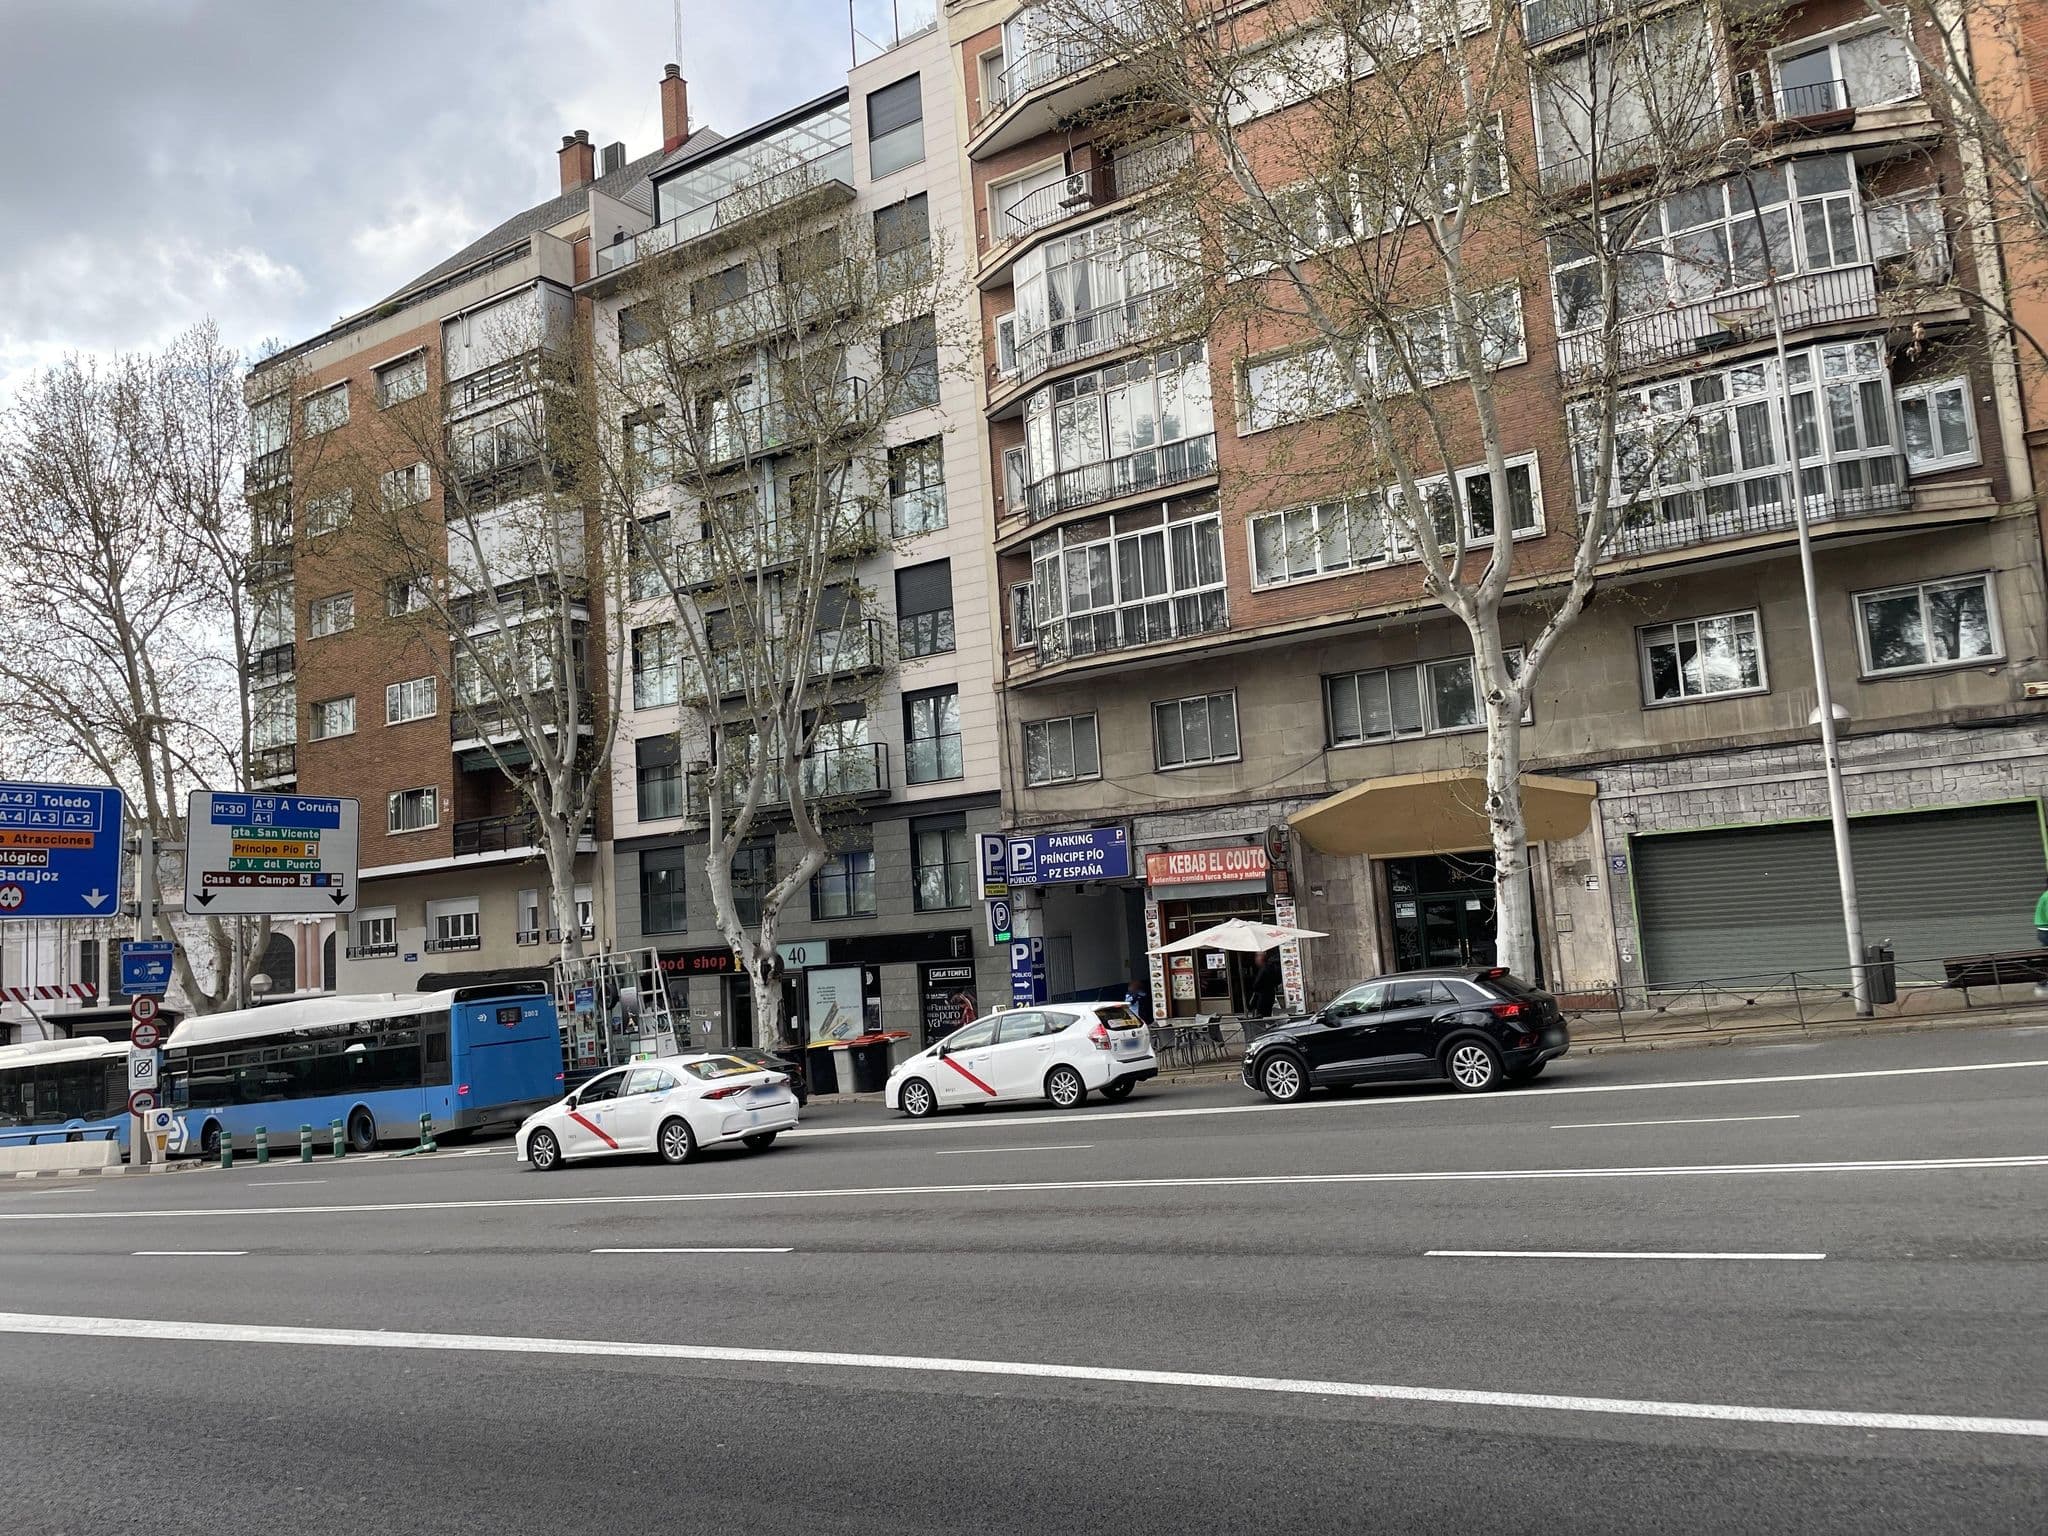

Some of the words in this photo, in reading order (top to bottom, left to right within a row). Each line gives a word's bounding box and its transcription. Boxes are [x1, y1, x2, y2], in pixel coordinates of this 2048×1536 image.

[0, 793, 33, 804] A-42
[42, 795, 91, 808] Toledo
[255, 798, 274, 808] A-6
[281, 800, 290, 810] A
[297, 801, 339, 813] Coruña
[215, 805, 244, 814] M-30
[0, 811, 23, 821] A-4
[32, 813, 57, 823] A-3
[66, 814, 90, 824] A-2
[255, 814, 270, 823] A-1
[13, 834, 91, 845] Atracciones
[232, 828, 255, 838] gta.
[257, 828, 278, 838] San
[281, 829, 319, 839] Vicente
[1049, 834, 1093, 848] PARKING
[1115, 829, 1123, 840] P
[984, 837, 1004, 876] P
[1011, 843, 1032, 872] P
[1040, 851, 1085, 865] PRÍNCIPE
[1086, 848, 1104, 861] PÍO
[1169, 853, 1206, 874] KEBAB
[1210, 852, 1224, 872] EL
[1226, 849, 1266, 871] COUTO
[247, 859, 257, 868] V.
[264, 860, 280, 869] del
[287, 860, 320, 869] Puerto
[1049, 868, 1062, 879] PZ
[1063, 863, 1103, 878] ESPAÑA
[0, 870, 59, 884] Badajoz
[203, 874, 231, 884] Casa
[238, 875, 252, 884] de
[258, 875, 295, 886] Campo
[1010, 875, 1037, 884] PÚBLICO
[1182, 874, 1204, 882] comida
[1222, 872, 1238, 880] Sana
[1, 893, 9, 901] 4
[996, 907, 1006, 926] P
[788, 947, 806, 964] 40
[1011, 943, 1029, 970] P
[659, 957, 685, 970] ood
[693, 956, 727, 971] shop
[932, 970, 946, 978] SALA
[947, 969, 968, 977] TEMPLE
